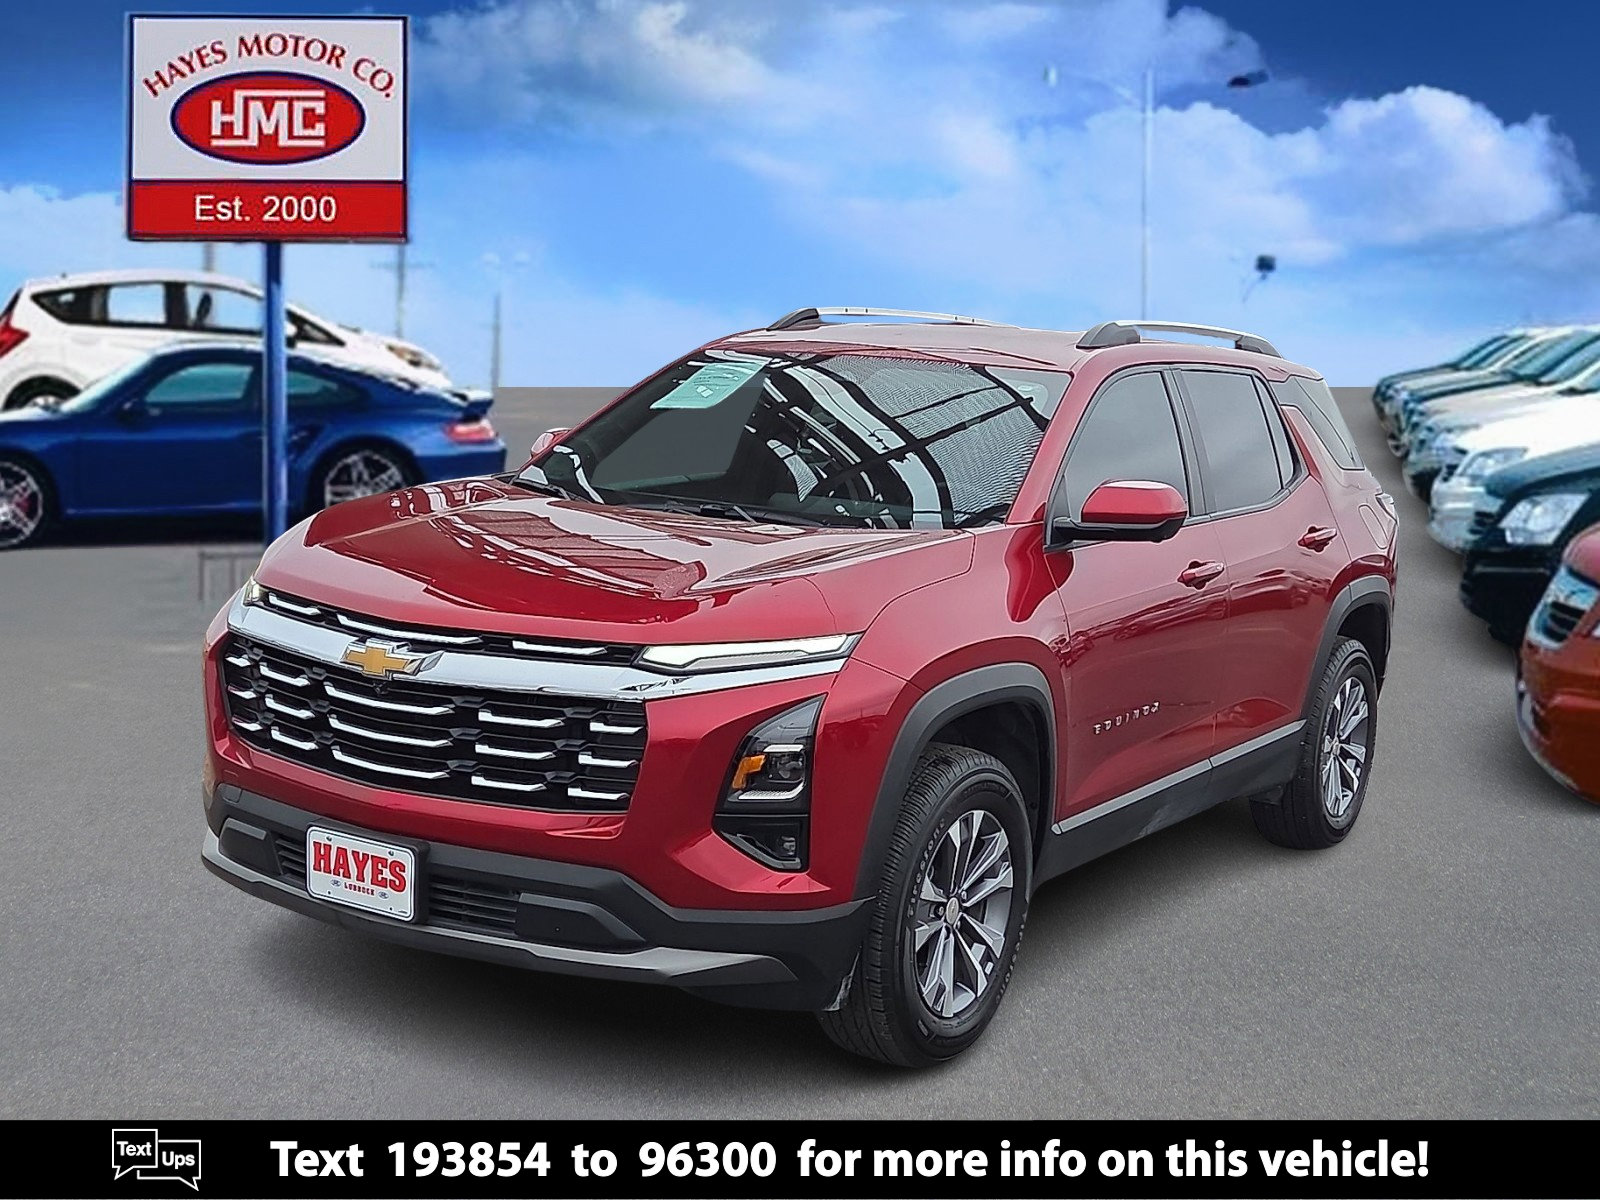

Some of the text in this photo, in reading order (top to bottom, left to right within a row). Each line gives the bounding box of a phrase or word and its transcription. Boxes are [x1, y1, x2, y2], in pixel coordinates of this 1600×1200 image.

[143, 33, 395, 98] HAYES MOTOR CO.
[210, 89, 326, 147] HMC
[195, 195, 337, 222] Est. 2000
[312, 840, 407, 893] HAYES
